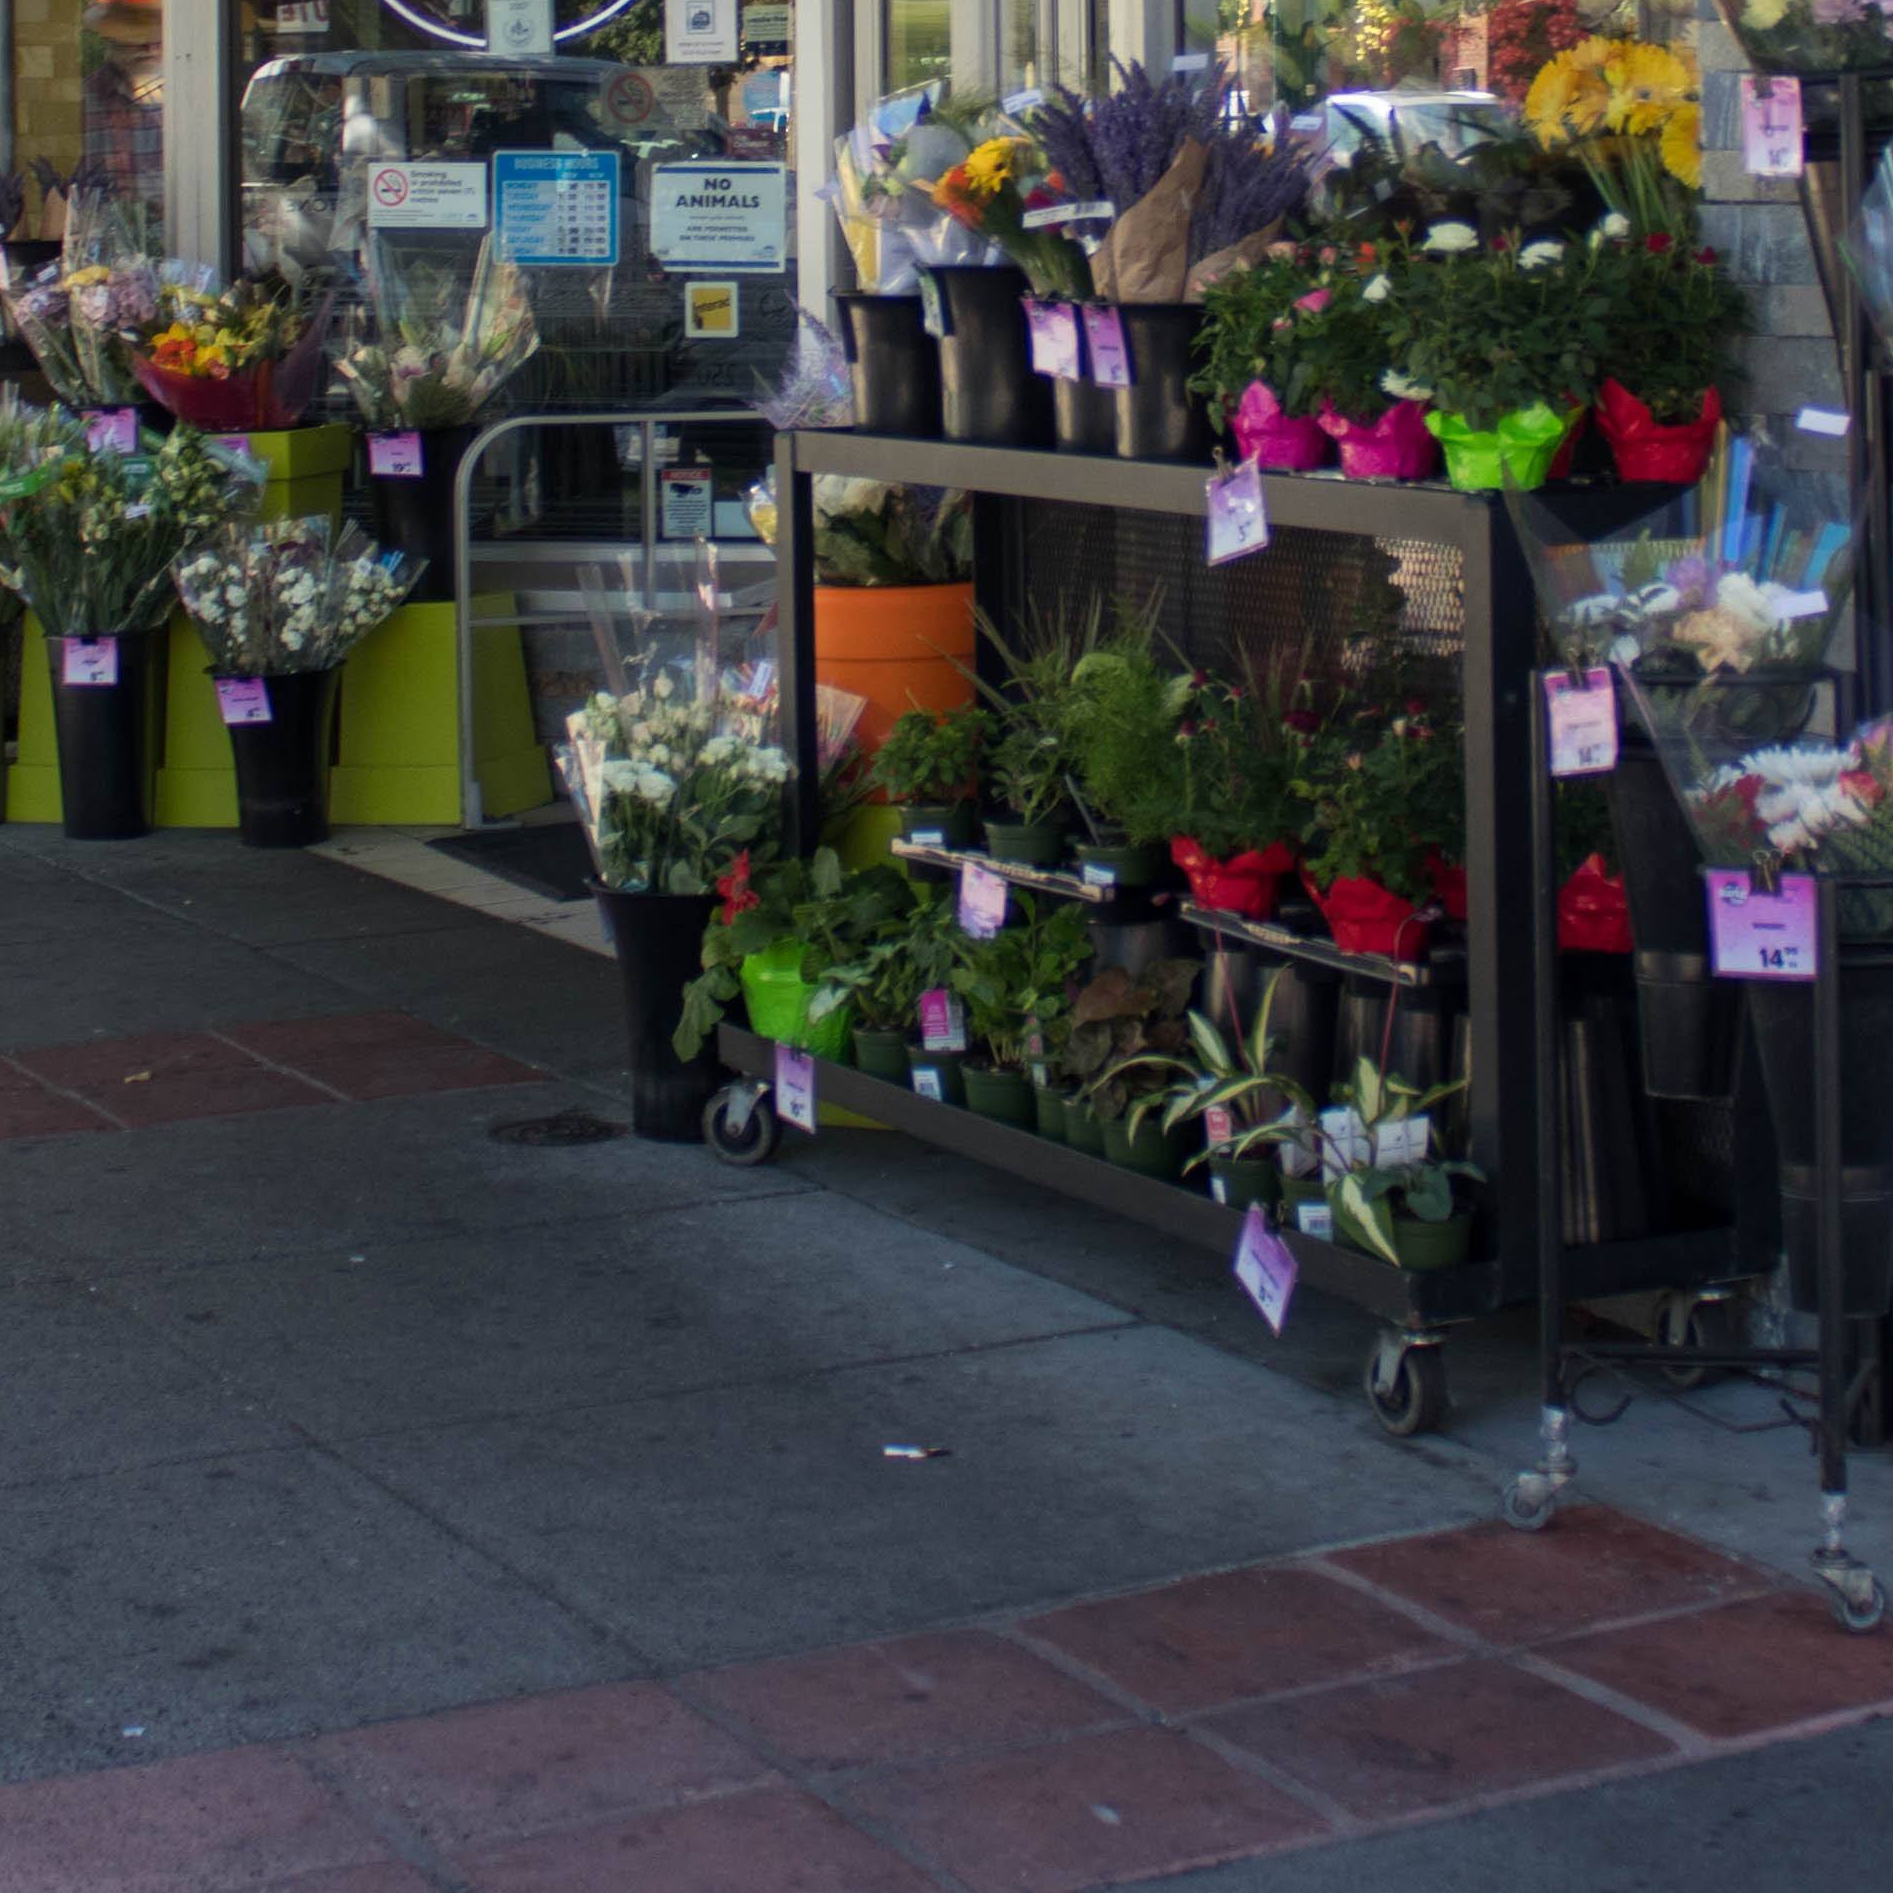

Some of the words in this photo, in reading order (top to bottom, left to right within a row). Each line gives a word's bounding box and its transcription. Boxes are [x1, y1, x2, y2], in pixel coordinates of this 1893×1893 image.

[703, 178, 732, 191] NO
[675, 194, 761, 209] ANIMALS
[1759, 947, 1785, 969] 14
